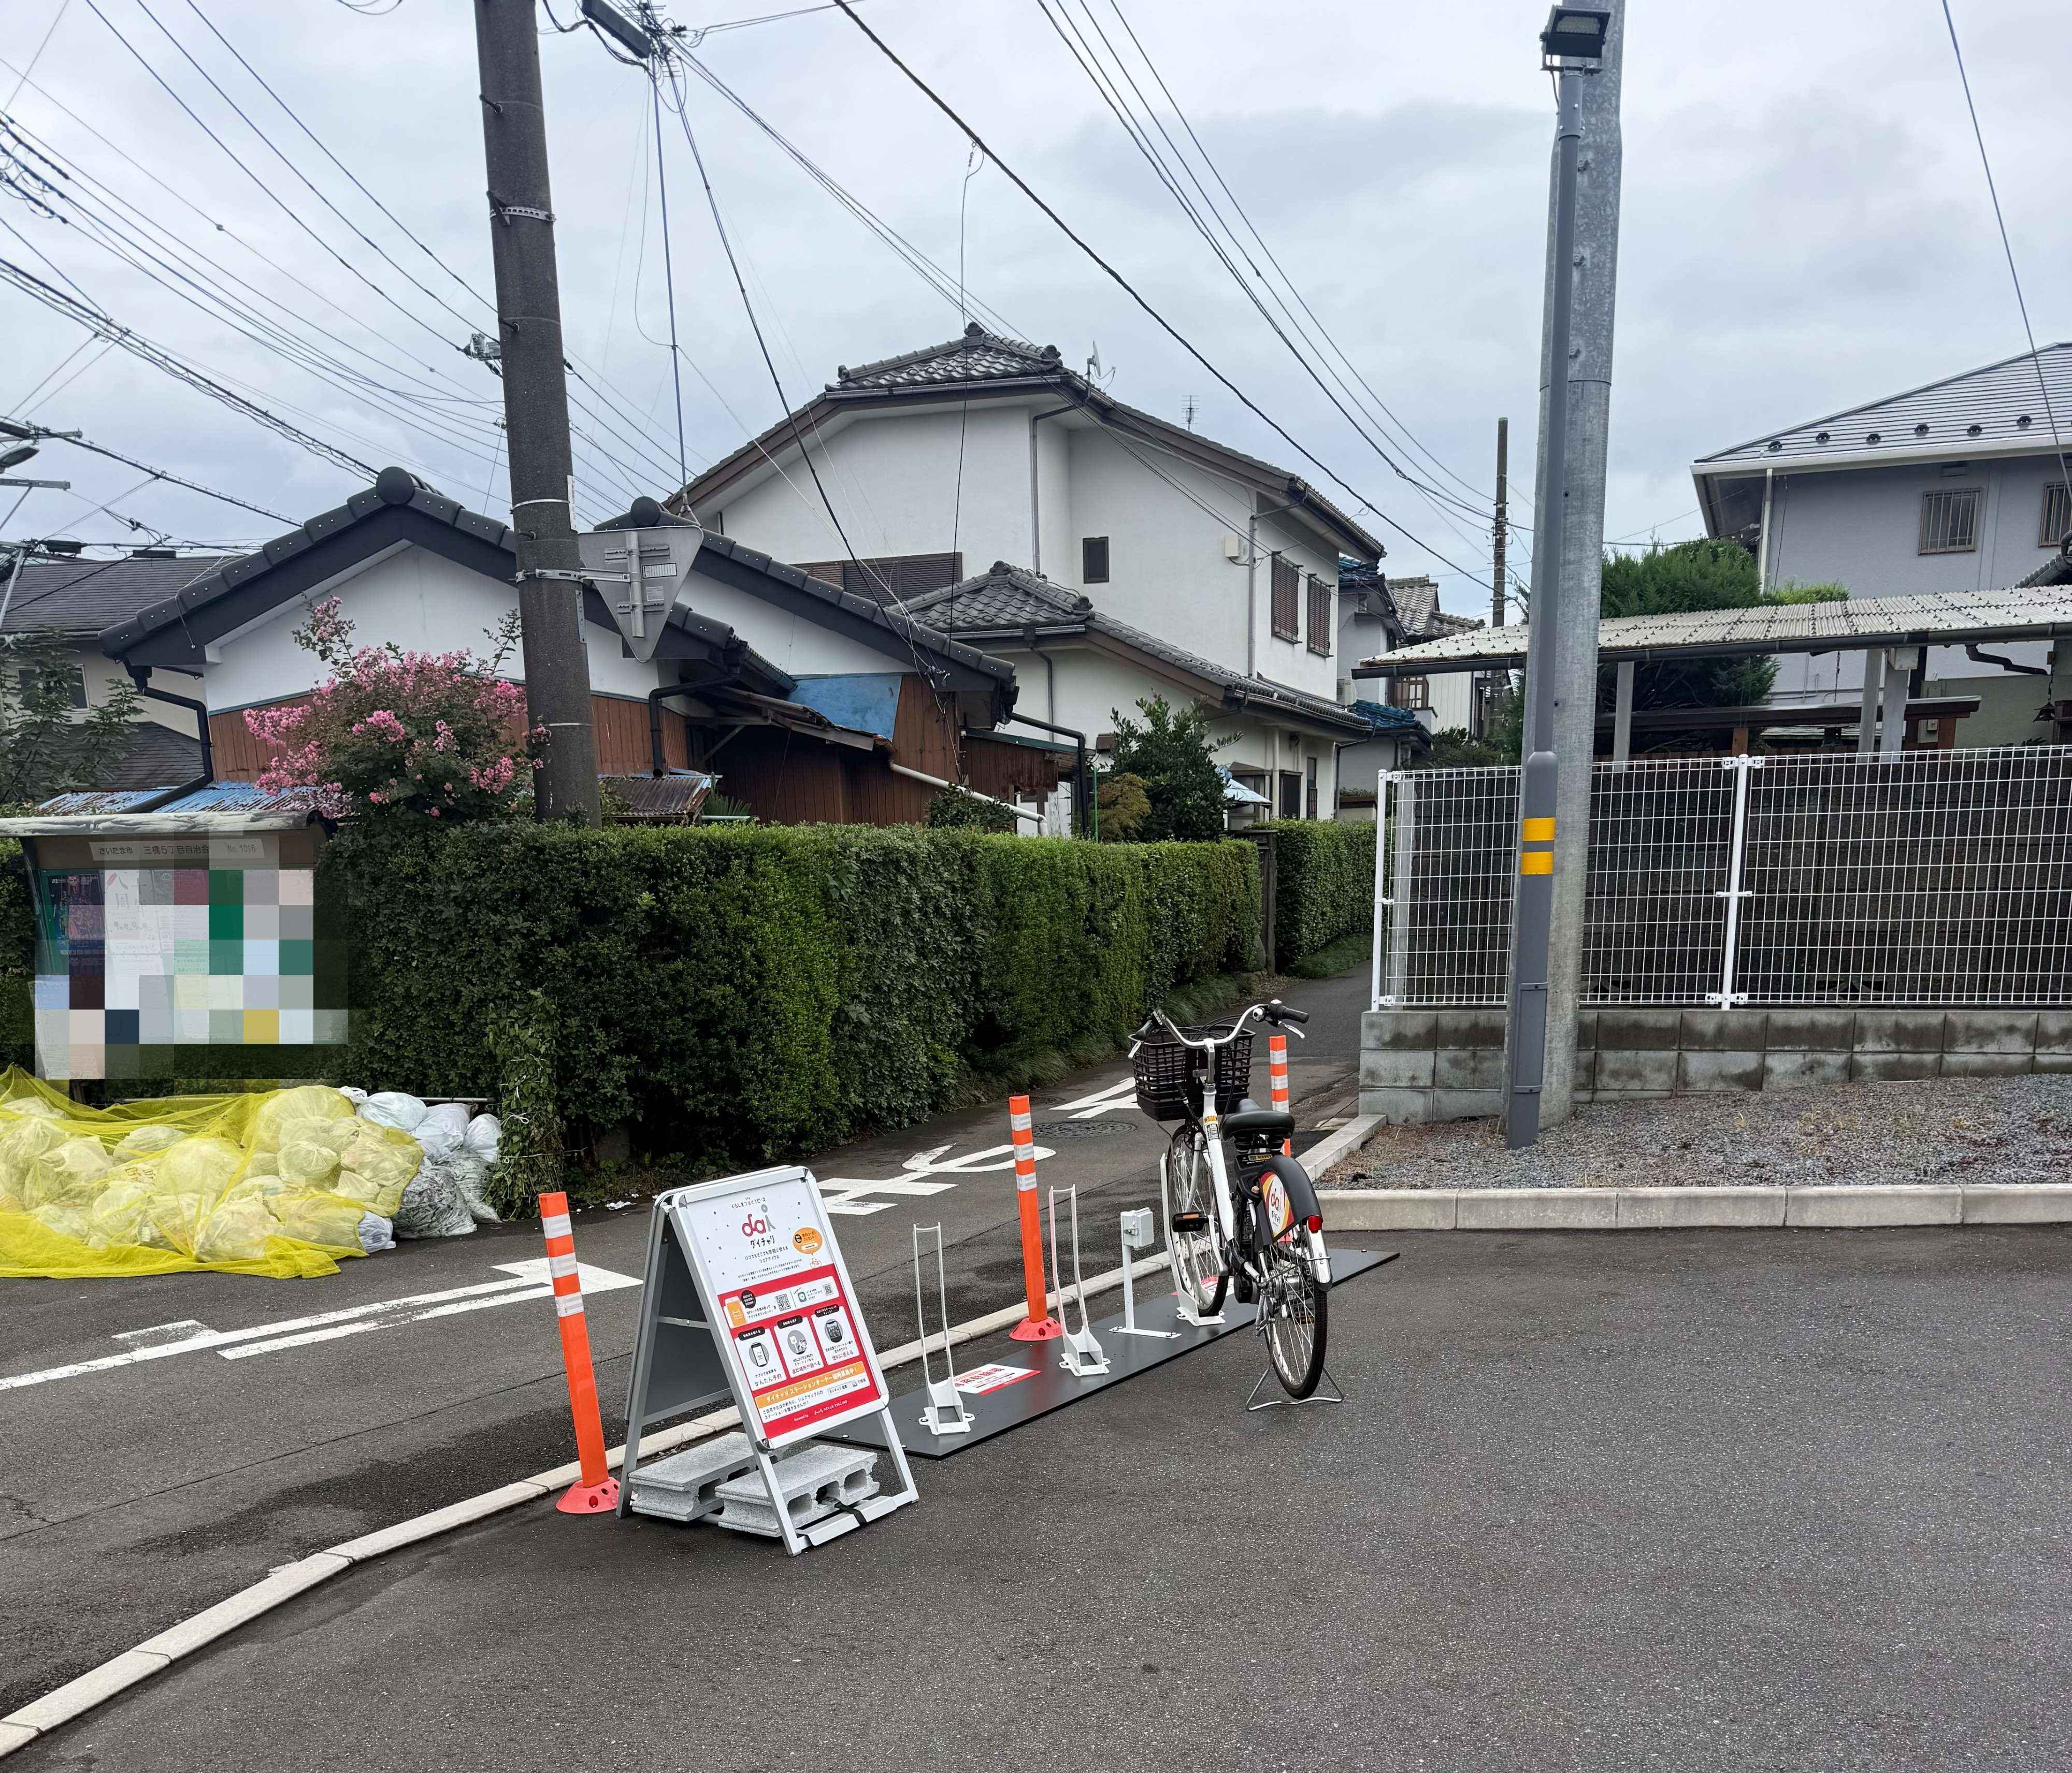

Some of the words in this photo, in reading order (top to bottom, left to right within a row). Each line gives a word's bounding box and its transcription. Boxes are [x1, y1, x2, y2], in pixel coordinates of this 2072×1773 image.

[99, 846, 134, 855] さいたま市
[750, 1235, 775, 1249] ダイチャリ
